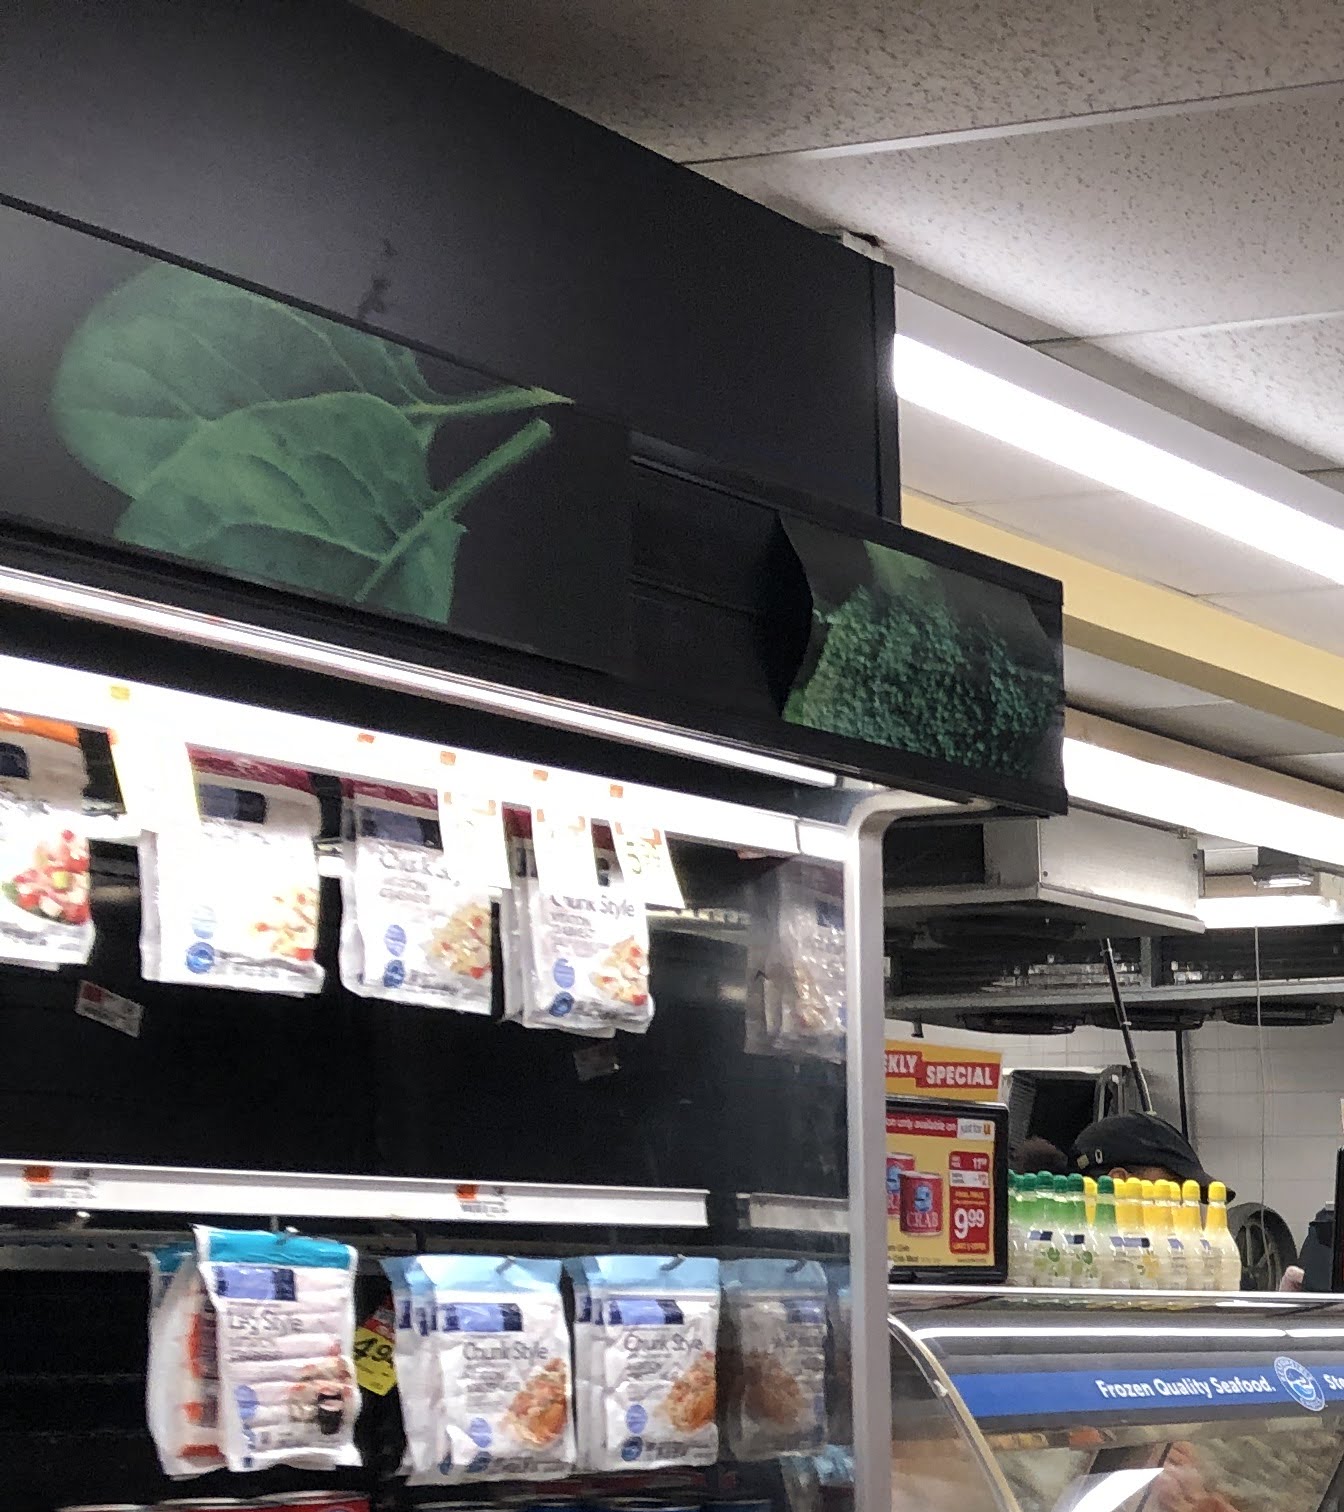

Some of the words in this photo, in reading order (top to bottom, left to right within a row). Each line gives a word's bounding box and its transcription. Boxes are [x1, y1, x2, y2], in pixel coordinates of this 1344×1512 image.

[885, 1053, 917, 1074] KLY
[926, 1065, 992, 1086] SPECIAL
[462, 1342, 508, 1361] Chunk
[511, 1341, 548, 1362] Style
[623, 1333, 668, 1353] Chunk
[1095, 1379, 1152, 1399] Frozen
[1153, 1378, 1212, 1399] Quality
[1211, 1375, 1276, 1394] Seafood.
